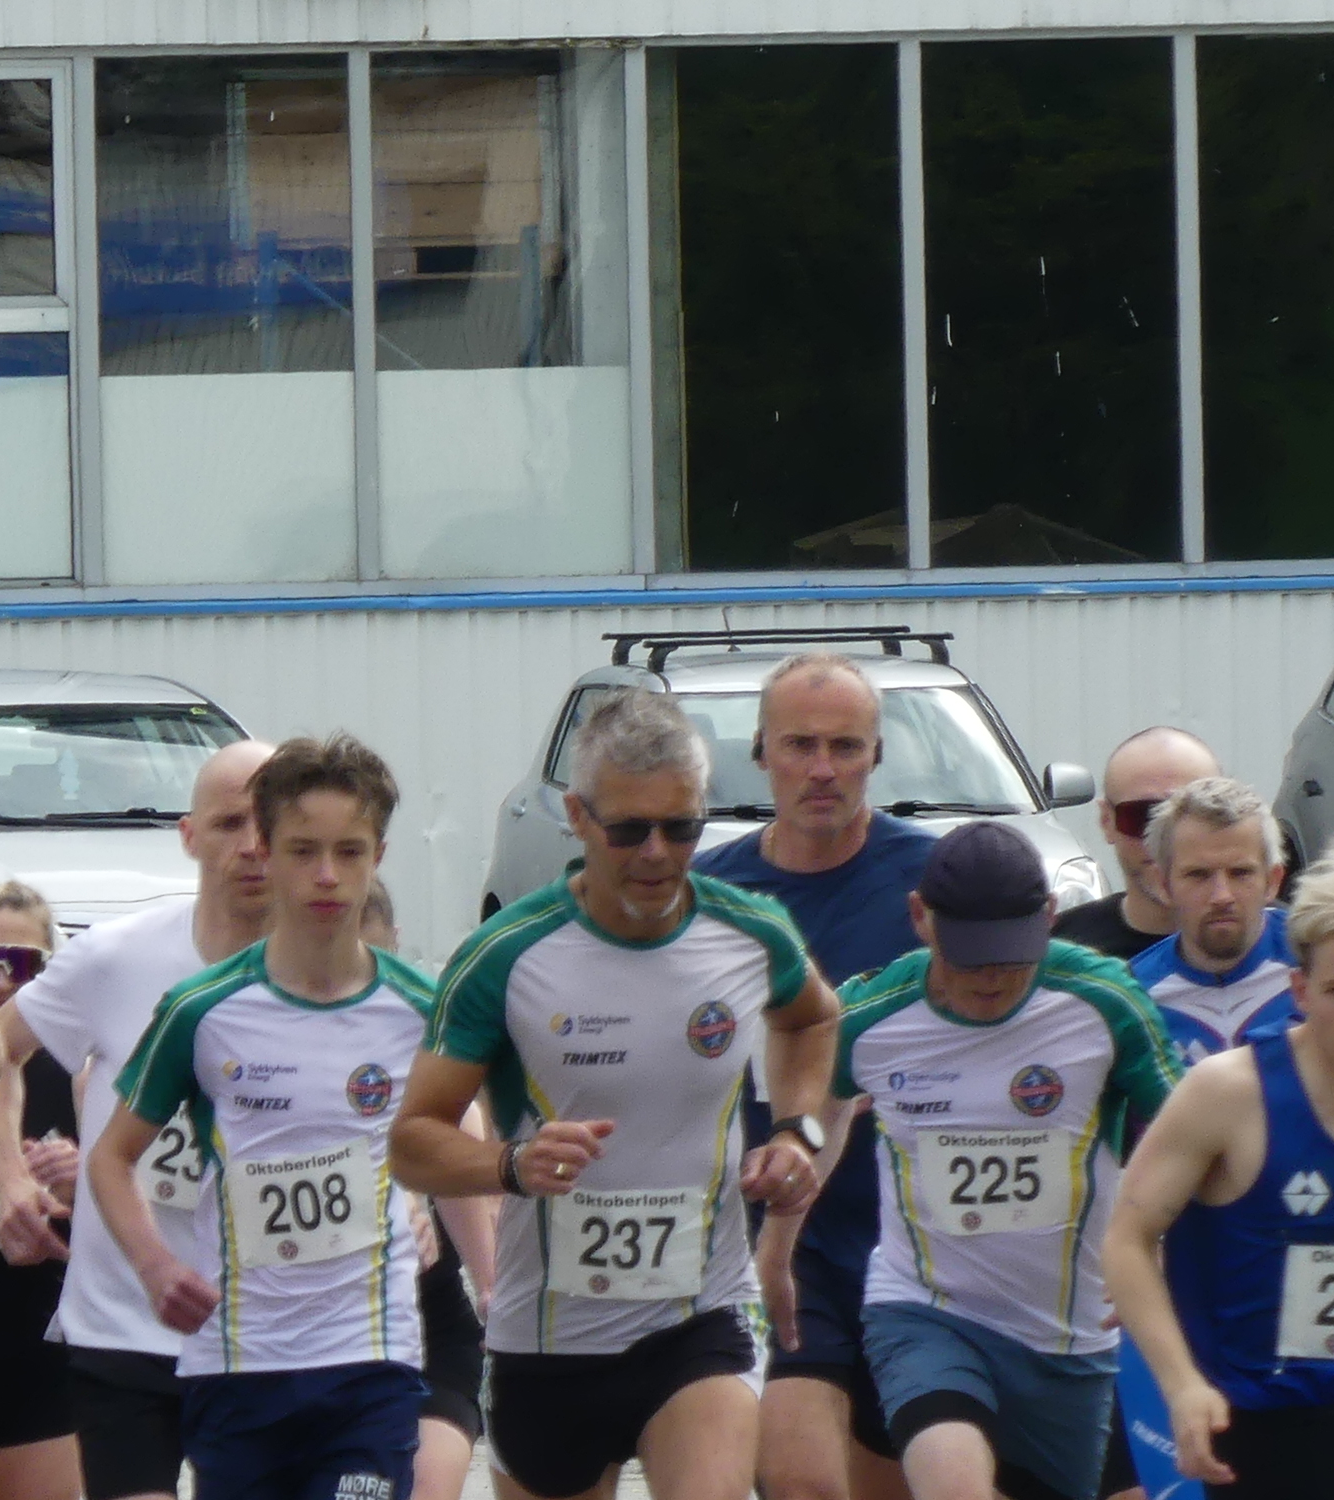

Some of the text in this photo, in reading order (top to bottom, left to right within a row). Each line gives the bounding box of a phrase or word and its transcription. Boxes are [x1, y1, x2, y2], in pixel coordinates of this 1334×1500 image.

[562, 1050, 627, 1066] TRIMTEX
[234, 1094, 293, 1111] TRIMTEX
[949, 1155, 1041, 1205] 225
[259, 1172, 352, 1236] 208
[578, 1215, 676, 1270] 237
[338, 1474, 392, 1499] MØRE
